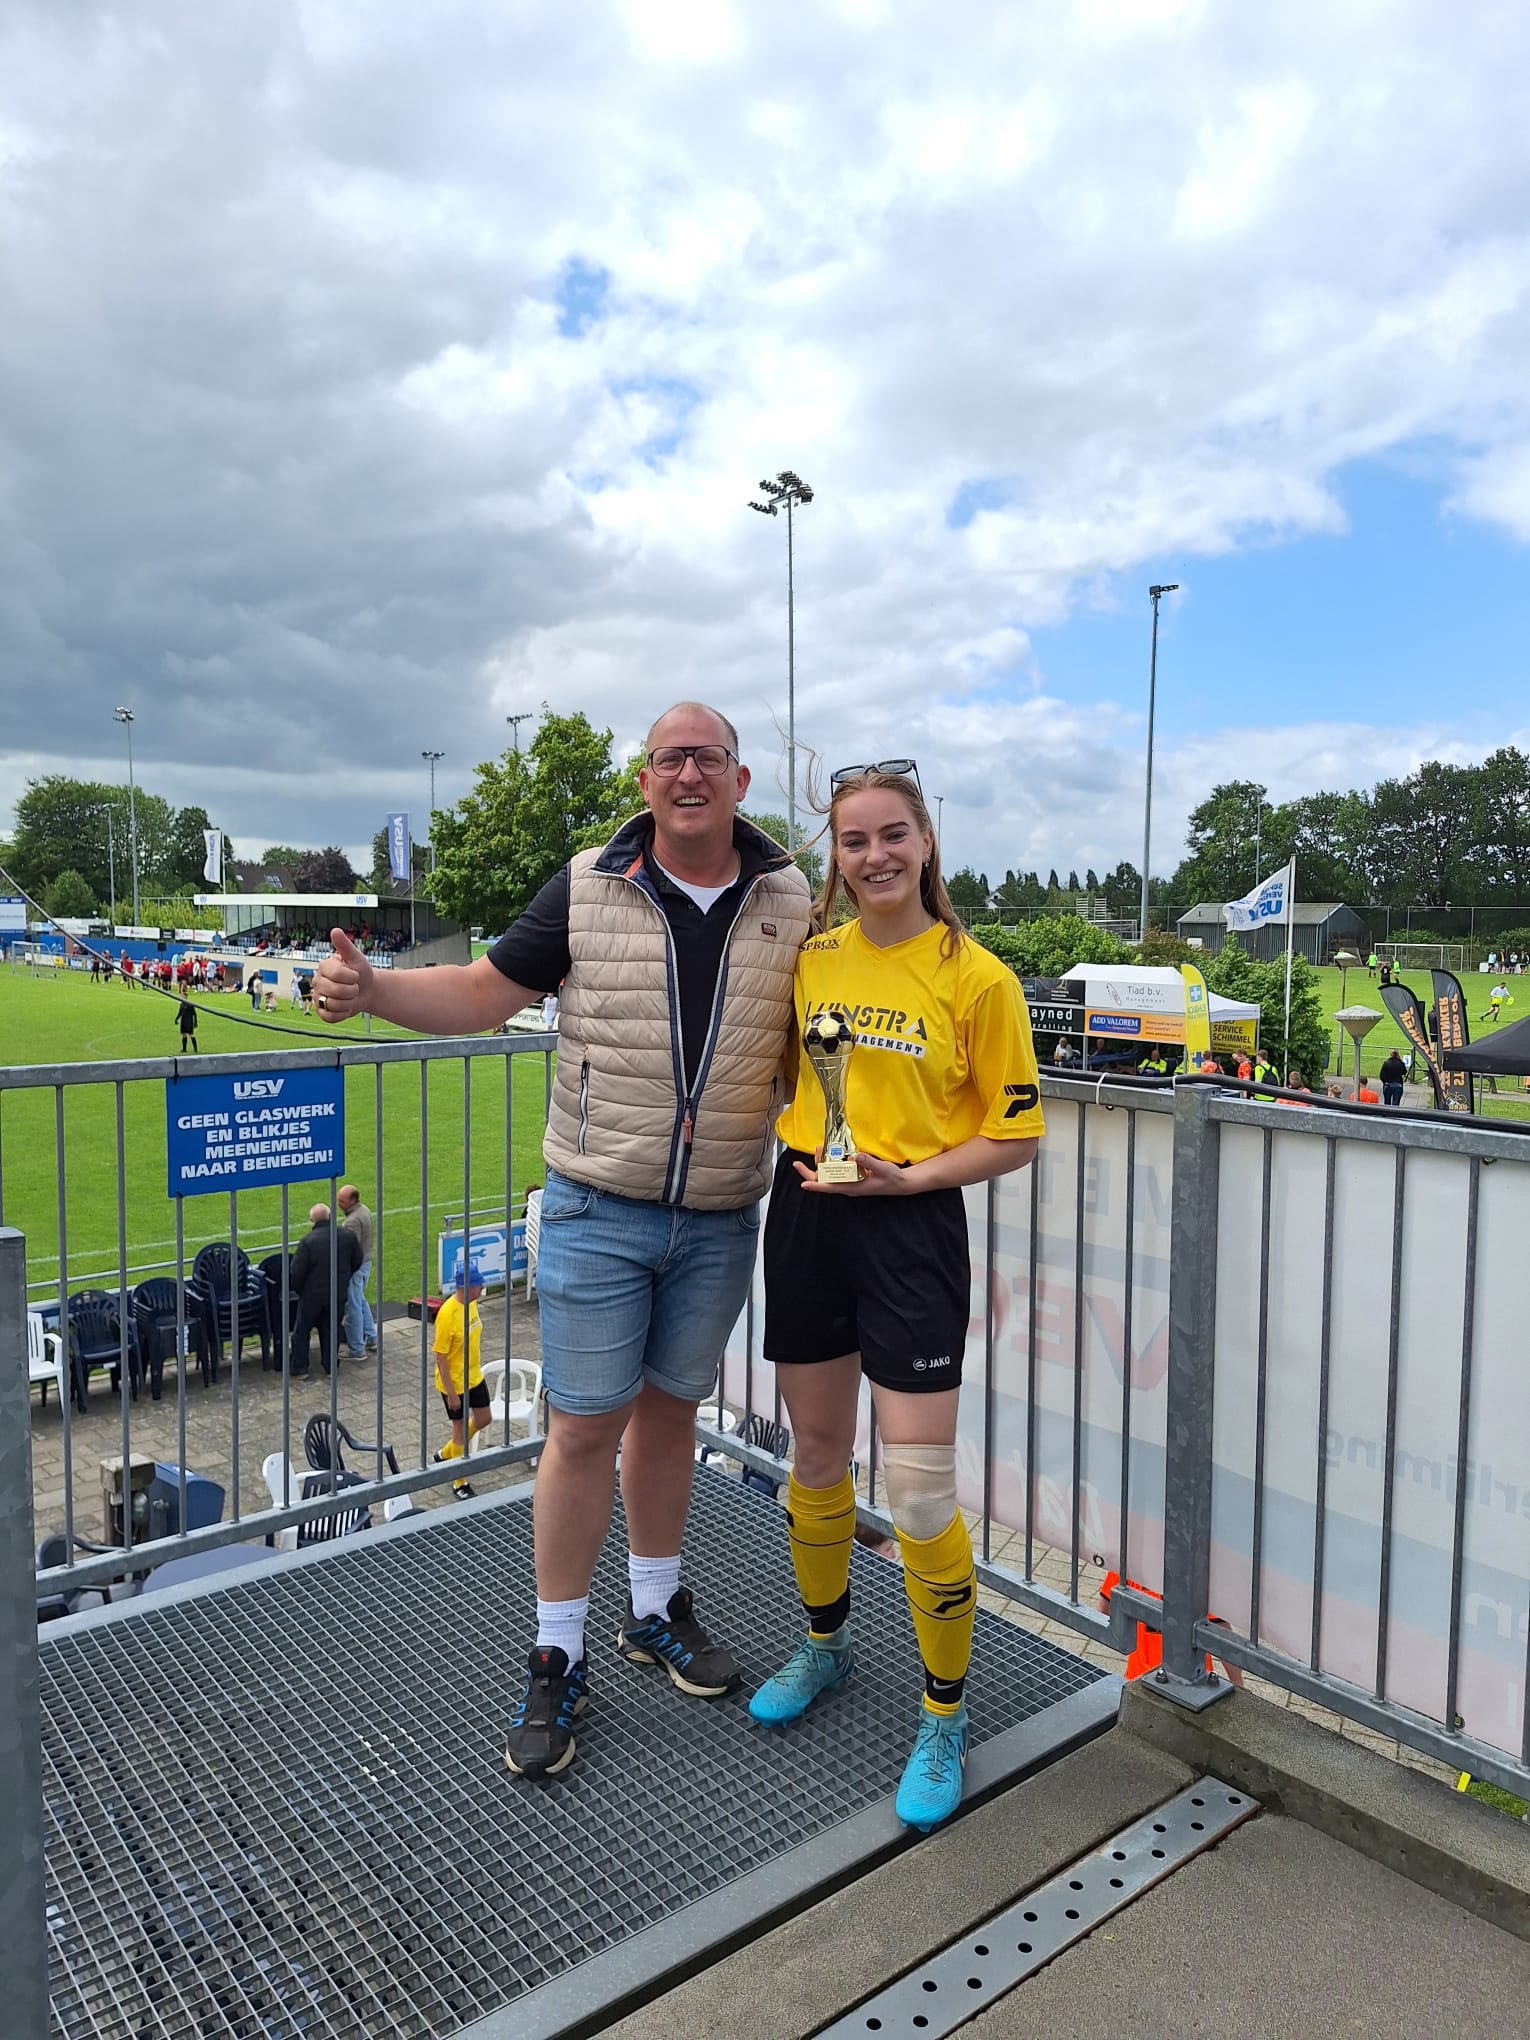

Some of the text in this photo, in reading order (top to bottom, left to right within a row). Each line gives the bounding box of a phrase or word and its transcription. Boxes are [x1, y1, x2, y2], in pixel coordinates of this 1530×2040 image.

[1092, 1016, 1106, 1024] ADD
[1107, 1017, 1139, 1027] VALOREM
[1213, 1025, 1243, 1034] SERVICE
[856, 1035, 923, 1055] AGEMENT
[1213, 1033, 1252, 1044] SCHIMMEL
[233, 1079, 285, 1097] USV
[177, 1103, 335, 1129] GEEN GLASWERK
[207, 1121, 310, 1143] EN BLIKJES
[205, 1136, 312, 1159] MEENEMEN
[181, 1150, 333, 1179] NAAR BENEDEN!
[928, 1356, 950, 1368] JAKO
